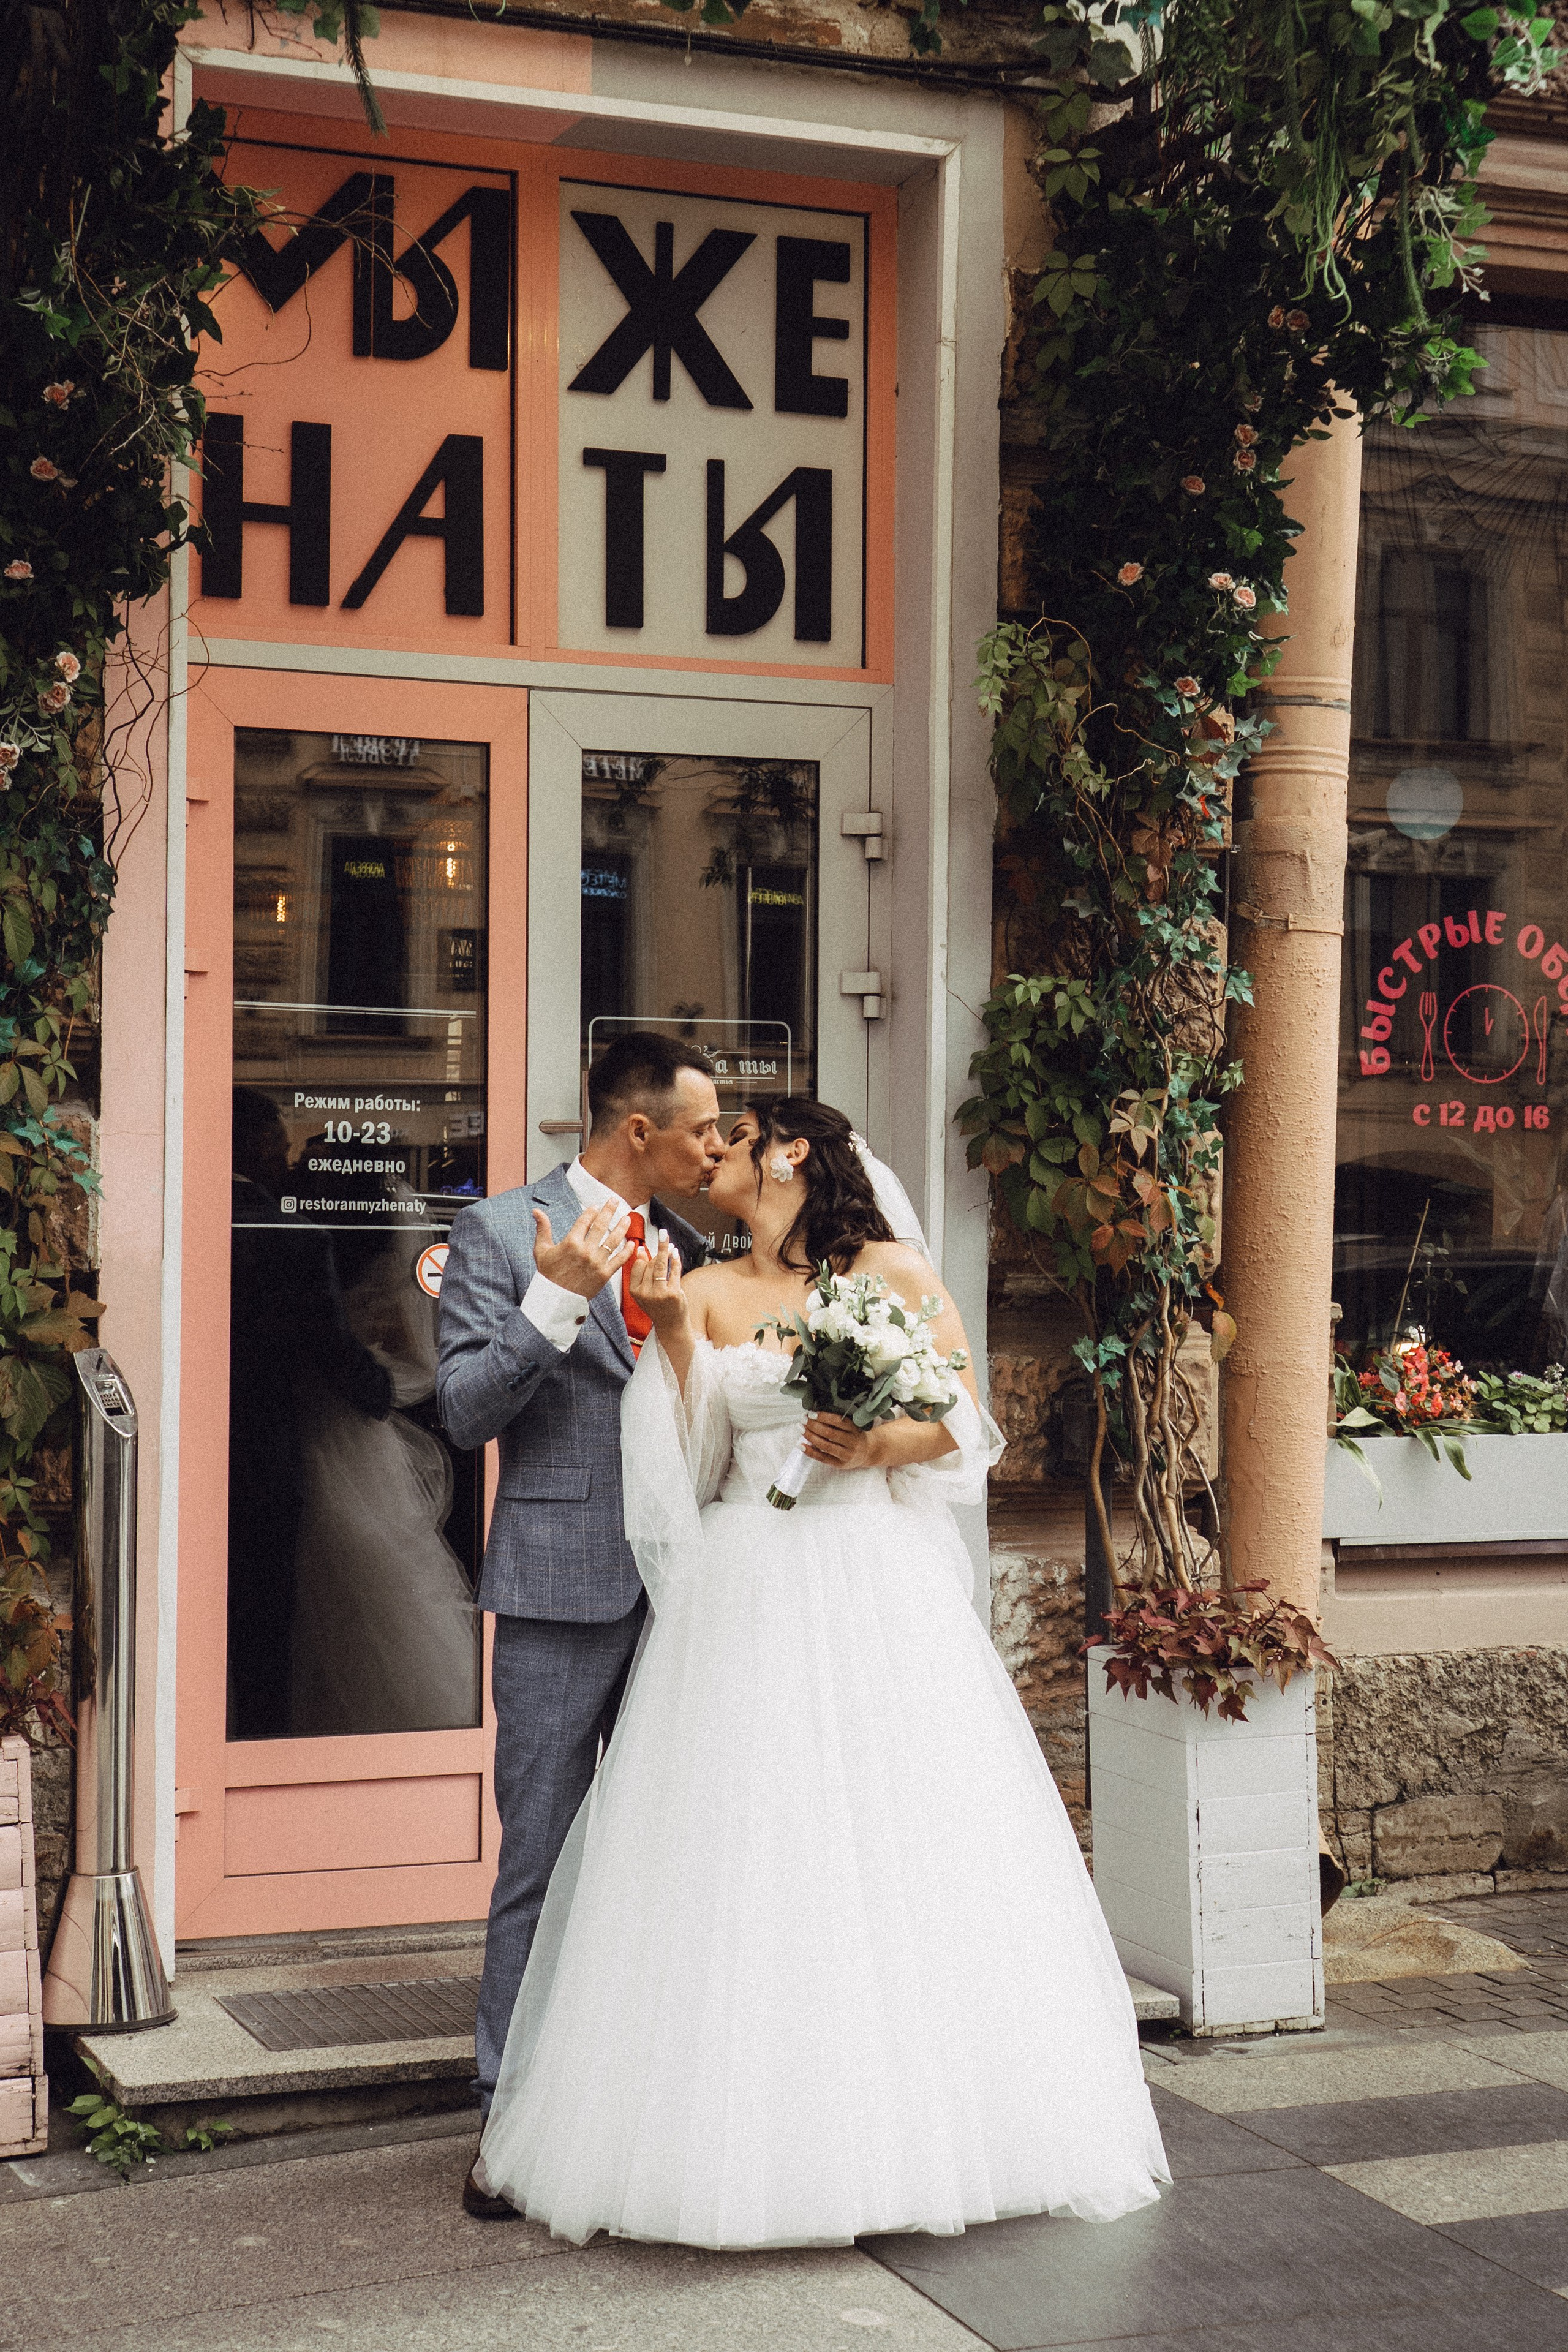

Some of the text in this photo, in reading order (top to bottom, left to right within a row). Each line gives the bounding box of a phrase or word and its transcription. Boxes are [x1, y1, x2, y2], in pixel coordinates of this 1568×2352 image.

[209, 170, 851, 418] МЫ ЖЕ
[200, 412, 833, 643] НА ТЫ
[1359, 910, 1507, 1076] БЫСТРЫЕ
[739, 1060, 778, 1075] ты
[295, 1092, 421, 1113] Режим работы:
[1439, 1101, 1466, 1126] 12
[1524, 1105, 1550, 1129] 16
[323, 1120, 391, 1144] 10-23
[308, 1158, 405, 1174] ежедневно
[300, 1197, 426, 1215] restoranmyzhenaty
